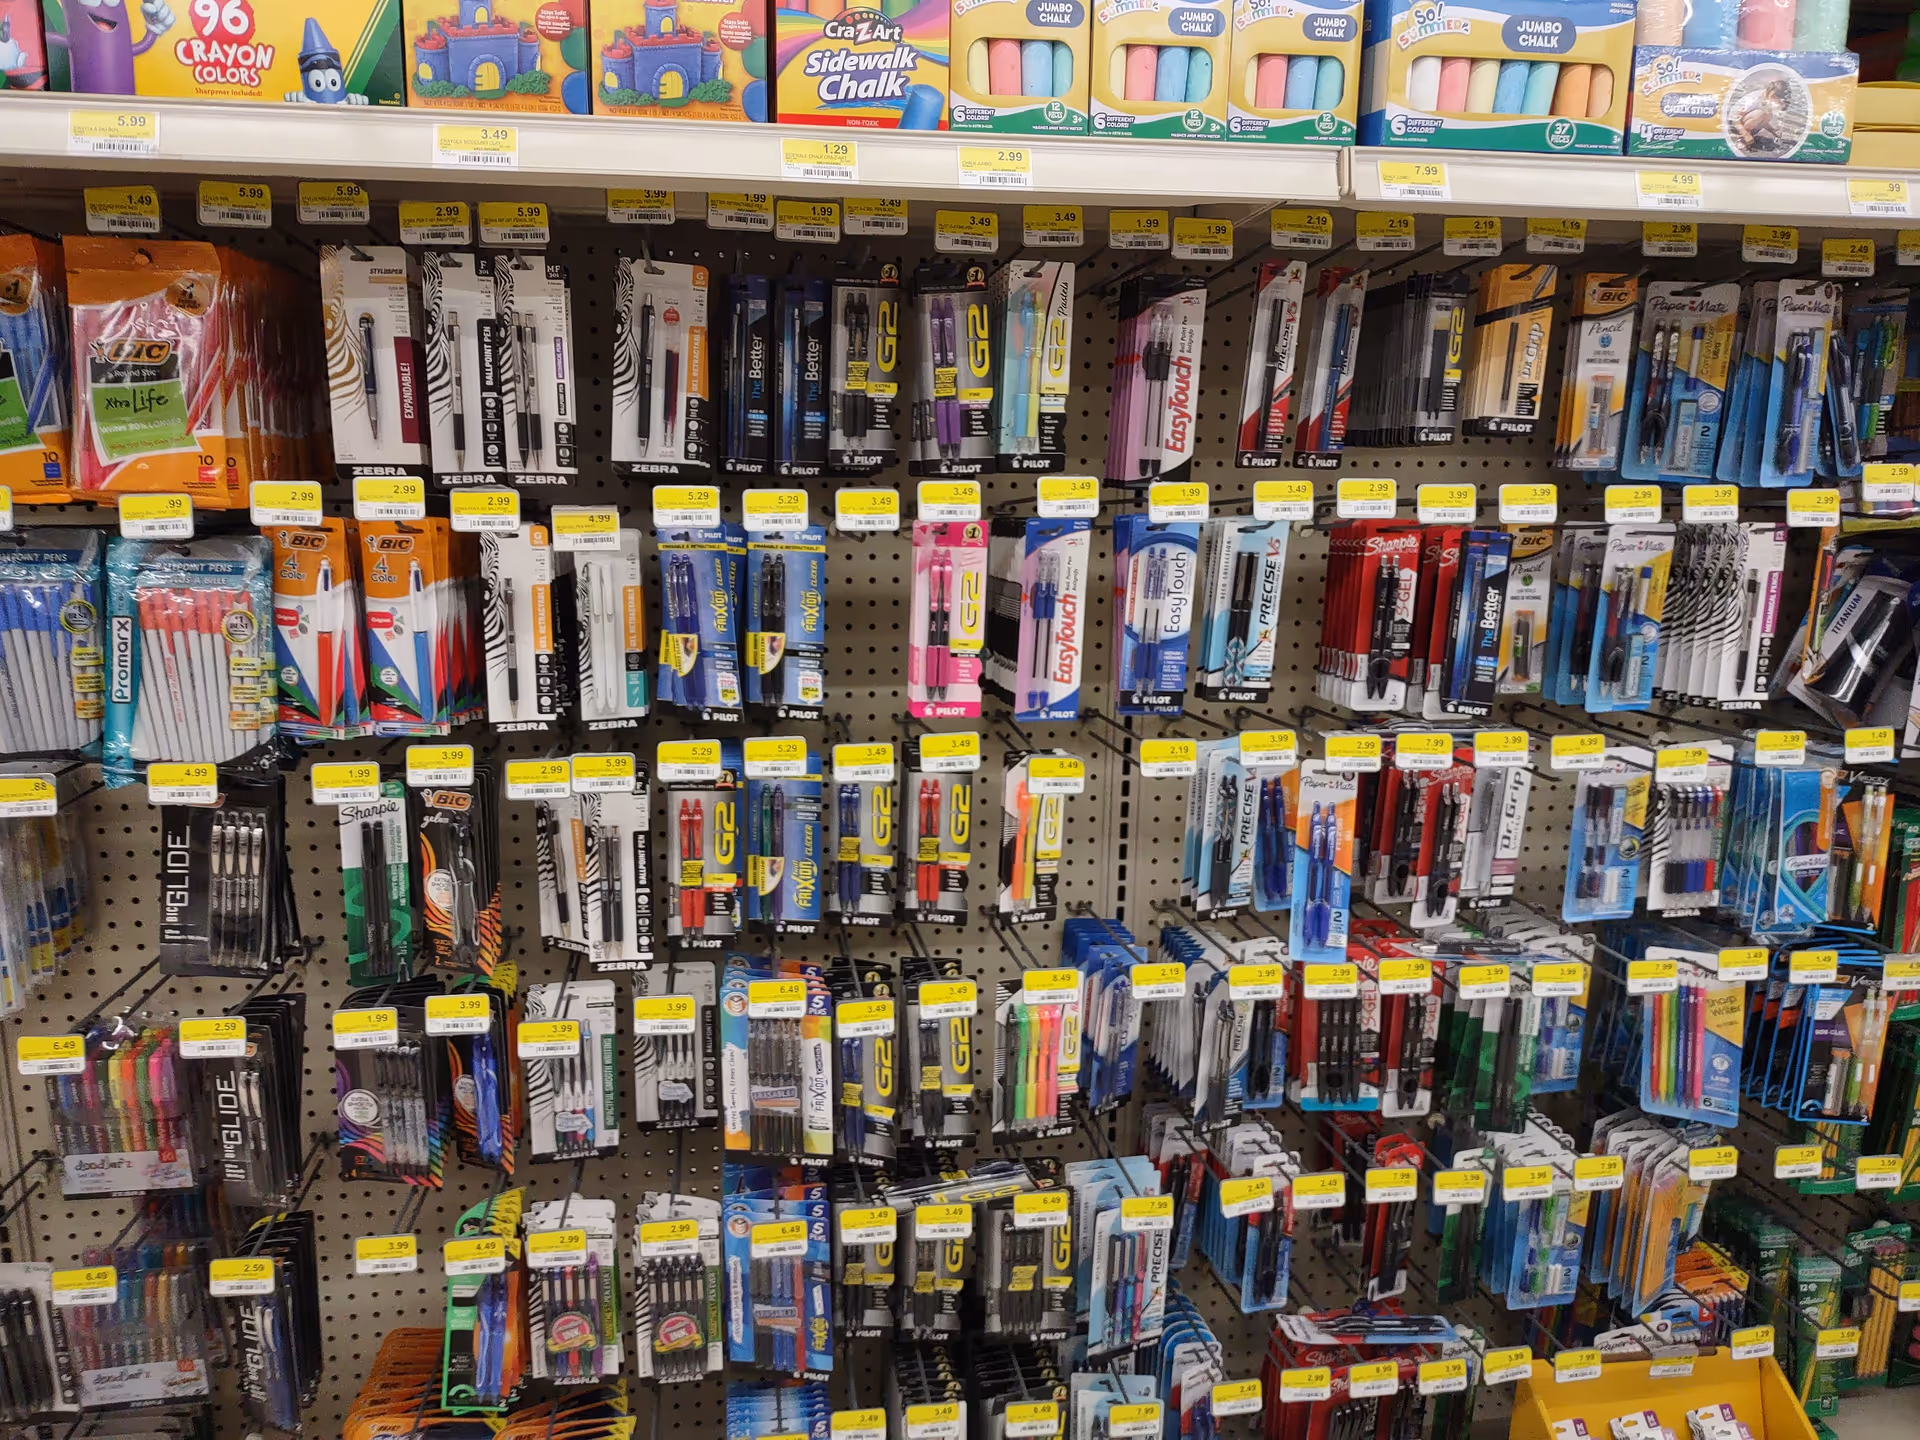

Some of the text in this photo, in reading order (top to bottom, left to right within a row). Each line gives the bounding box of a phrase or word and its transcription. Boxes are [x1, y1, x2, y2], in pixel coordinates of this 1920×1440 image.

[1037, 2, 1073, 13] JUMBO
[193, 0, 249, 36] 96
[1039, 13, 1071, 24] CHALK
[1180, 12, 1214, 24] JUMBO
[1313, 17, 1347, 27] JUMBO
[1181, 21, 1212, 33] CHALK
[1517, 20, 1562, 35] JUMBO
[1315, 27, 1345, 38] CHALK
[1519, 33, 1559, 48] CHALK
[177, 39, 275, 70] CRAYON
[805, 48, 917, 74] Sidewalk
[195, 65, 262, 86] COLORS
[817, 72, 908, 101] Chalk
[1691, 105, 1714, 115] STICK
[117, 116, 146, 127] 5.99
[846, 119, 879, 127] NON-TOXIC
[1392, 116, 1442, 134] 6 DIFFERENT
[1554, 123, 1569, 136] 37
[481, 130, 508, 141] 3.49
[1551, 134, 1570, 144] PIECES
[823, 144, 848, 154] 1.29
[998, 151, 1022, 162] 2.99
[1414, 166, 1437, 176] 7.99
[1672, 175, 1693, 184] 4.99
[239, 188, 263, 199] 5.99
[336, 185, 361, 196] 5.99
[127, 195, 152, 206] 1.49
[435, 206, 459, 217] 2.99
[811, 206, 833, 216] 1.99
[1055, 213, 1075, 222] 3.49
[1306, 215, 1327, 225] 2.19
[1136, 219, 1159, 228] 1.99
[1474, 220, 1494, 230] 2.19
[1850, 246, 1868, 254] 2.49
[1601, 292, 1628, 303] BIC
[1589, 322, 1624, 336] Pencil
[876, 300, 897, 373] G2
[1448, 306, 1465, 363] G2
[968, 304, 988, 378] G2
[1278, 323, 1292, 373] PRECISE
[751, 334, 764, 379] Better
[485, 347, 493, 386] BALLPOINT
[404, 362, 414, 418] EXPANDABLE!
[132, 388, 169, 415] Life
[1165, 355, 1192, 453] EasyTouch
[1501, 424, 1532, 432] PILOT
[1428, 433, 1452, 442] PILOT
[199, 456, 213, 465] 10
[1023, 460, 1050, 469] PILOT
[1252, 458, 1277, 467] PILOT
[353, 466, 407, 475] ZEBRA
[737, 464, 763, 473] PILOT
[793, 466, 820, 476] PILOT
[1891, 469, 1909, 477] 2.59
[441, 474, 496, 484] ZEBRA
[515, 475, 568, 485] ZEBRA
[393, 485, 416, 494] 2.99
[1071, 482, 1091, 491] 3.49
[1369, 484, 1388, 492] 2.99
[291, 492, 314, 501] 2.99
[688, 492, 709, 501] 5.29
[953, 488, 973, 496] 3.49
[1182, 488, 1200, 497] 1.99
[1449, 491, 1468, 499] 3.99
[1532, 488, 1551, 496] 3.99
[166, 501, 182, 509] .99
[488, 497, 510, 506] 2.99
[292, 534, 323, 548] BIC
[1365, 535, 1417, 556] Sharpie
[284, 554, 297, 570] 4
[279, 569, 306, 582] Color
[1259, 559, 1276, 624] PRECISE
[960, 572, 980, 634] G2
[1831, 594, 1862, 634] TITANIUM
[1053, 594, 1077, 684] EasyTouch
[1229, 692, 1257, 701] PILOT
[1459, 706, 1487, 715] PILOT
[1721, 701, 1761, 710] ZEBRA
[714, 712, 738, 721] PILOT
[936, 707, 966, 716] PILOT
[1049, 711, 1074, 719] PILOT
[497, 722, 548, 731] ZEBRA
[589, 720, 637, 730] ZEBRA
[952, 740, 970, 748] 3.49
[1270, 735, 1289, 743] 3.99
[1170, 746, 1189, 754] 2.19
[1357, 741, 1375, 749] 2.99
[442, 751, 463, 759] 3.99
[692, 748, 712, 756] 5.29
[606, 759, 626, 767] 5.99
[1059, 761, 1078, 769] 8.49
[185, 769, 207, 777] 4.99
[1301, 776, 1327, 789] Paper
[436, 794, 467, 806] BIC
[341, 800, 400, 824] Sharpie
[872, 785, 890, 846] G2
[950, 784, 970, 844] G2
[1241, 786, 1254, 844] PRECISE
[167, 826, 190, 906] GLIDE
[1020, 913, 1046, 922] PILOT
[1662, 908, 1700, 917] ZEBRA
[852, 917, 879, 925] PILOT
[787, 925, 815, 933] PILOT
[598, 961, 646, 970] ZEBRA
[780, 985, 799, 994] 6.49
[460, 1001, 480, 1009] 3.99
[868, 1005, 886, 1013] 3.49
[215, 1023, 236, 1031] 2.59
[54, 1041, 75, 1050] 6.49
[874, 1038, 891, 1096] G2
[216, 1071, 242, 1145] GLIDE
[656, 1120, 699, 1128] ZEBRA
[1046, 1127, 1072, 1136] PILOT
[936, 1139, 962, 1147] PILOT
[801, 1158, 828, 1167] PILOT
[1150, 1201, 1167, 1209] 7.99
[671, 1225, 690, 1233] 2.99
[782, 1226, 800, 1234] 6.49
[388, 1242, 409, 1250] 3.99
[1151, 1230, 1164, 1283] PRECISE
[1041, 1332, 1066, 1340] PILOT
[805, 1373, 829, 1382] PILOT
